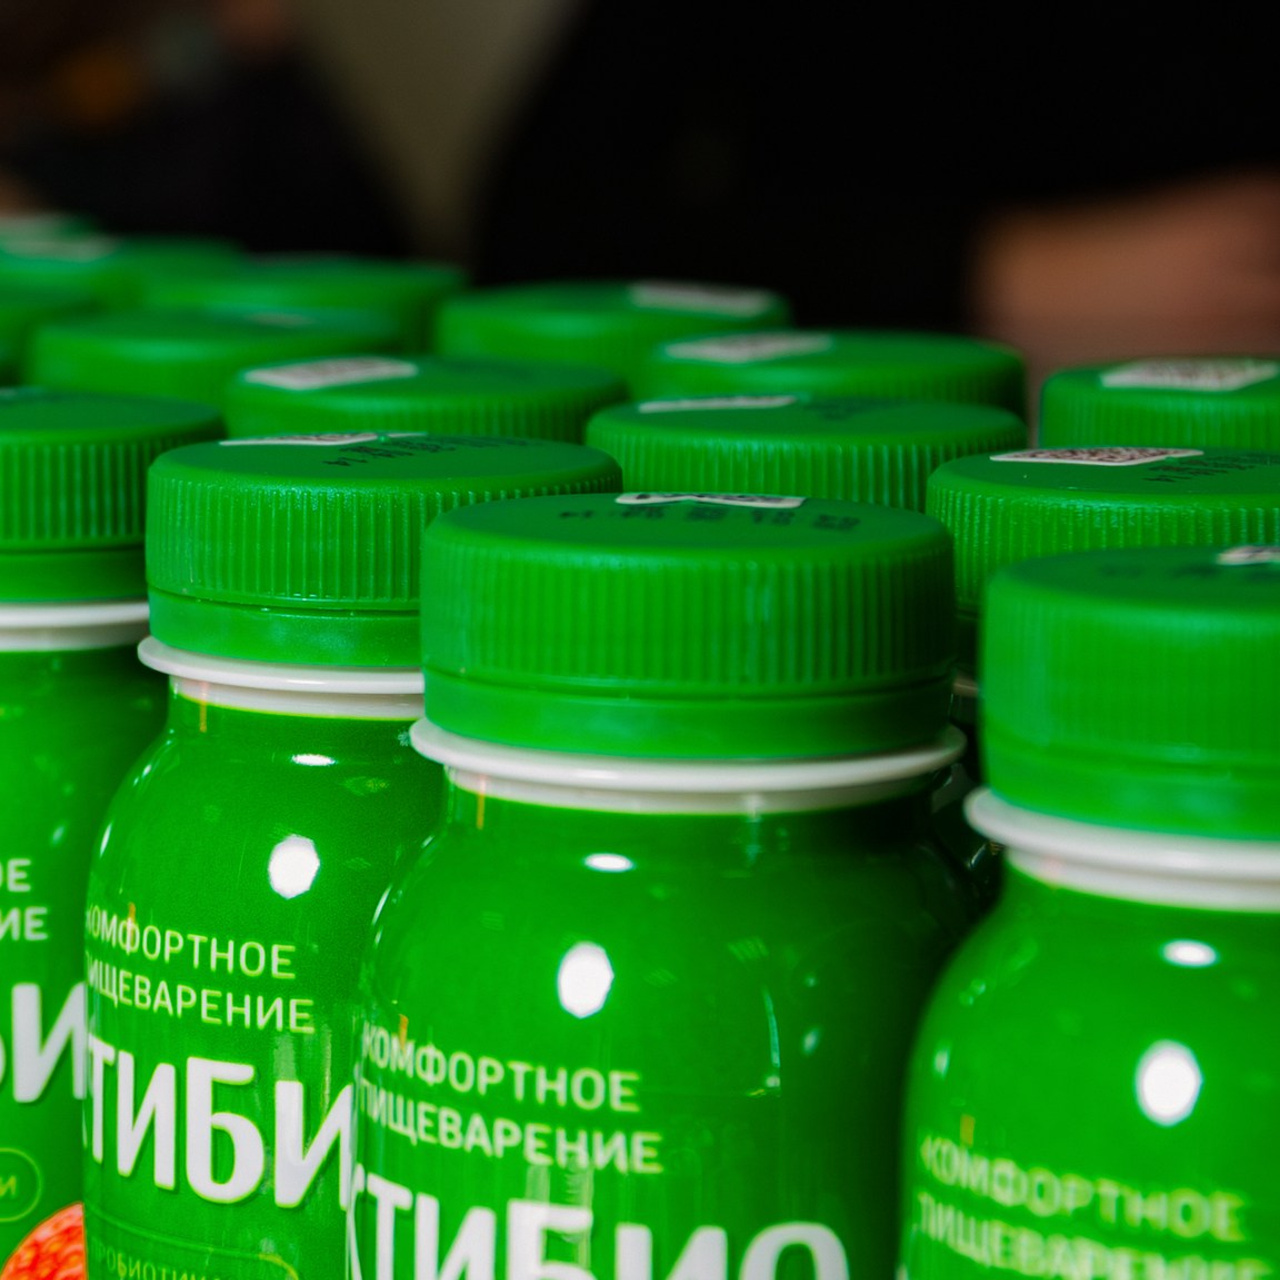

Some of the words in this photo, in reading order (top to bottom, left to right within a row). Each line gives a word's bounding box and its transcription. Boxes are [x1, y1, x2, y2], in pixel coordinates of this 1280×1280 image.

[361, 1018, 642, 1114] КОМФОРТНОЕ
[358, 1075, 664, 1175] ПИЩЕВАРЕНИЕ
[920, 1134, 1247, 1244] КОМФОРТНОЕ
